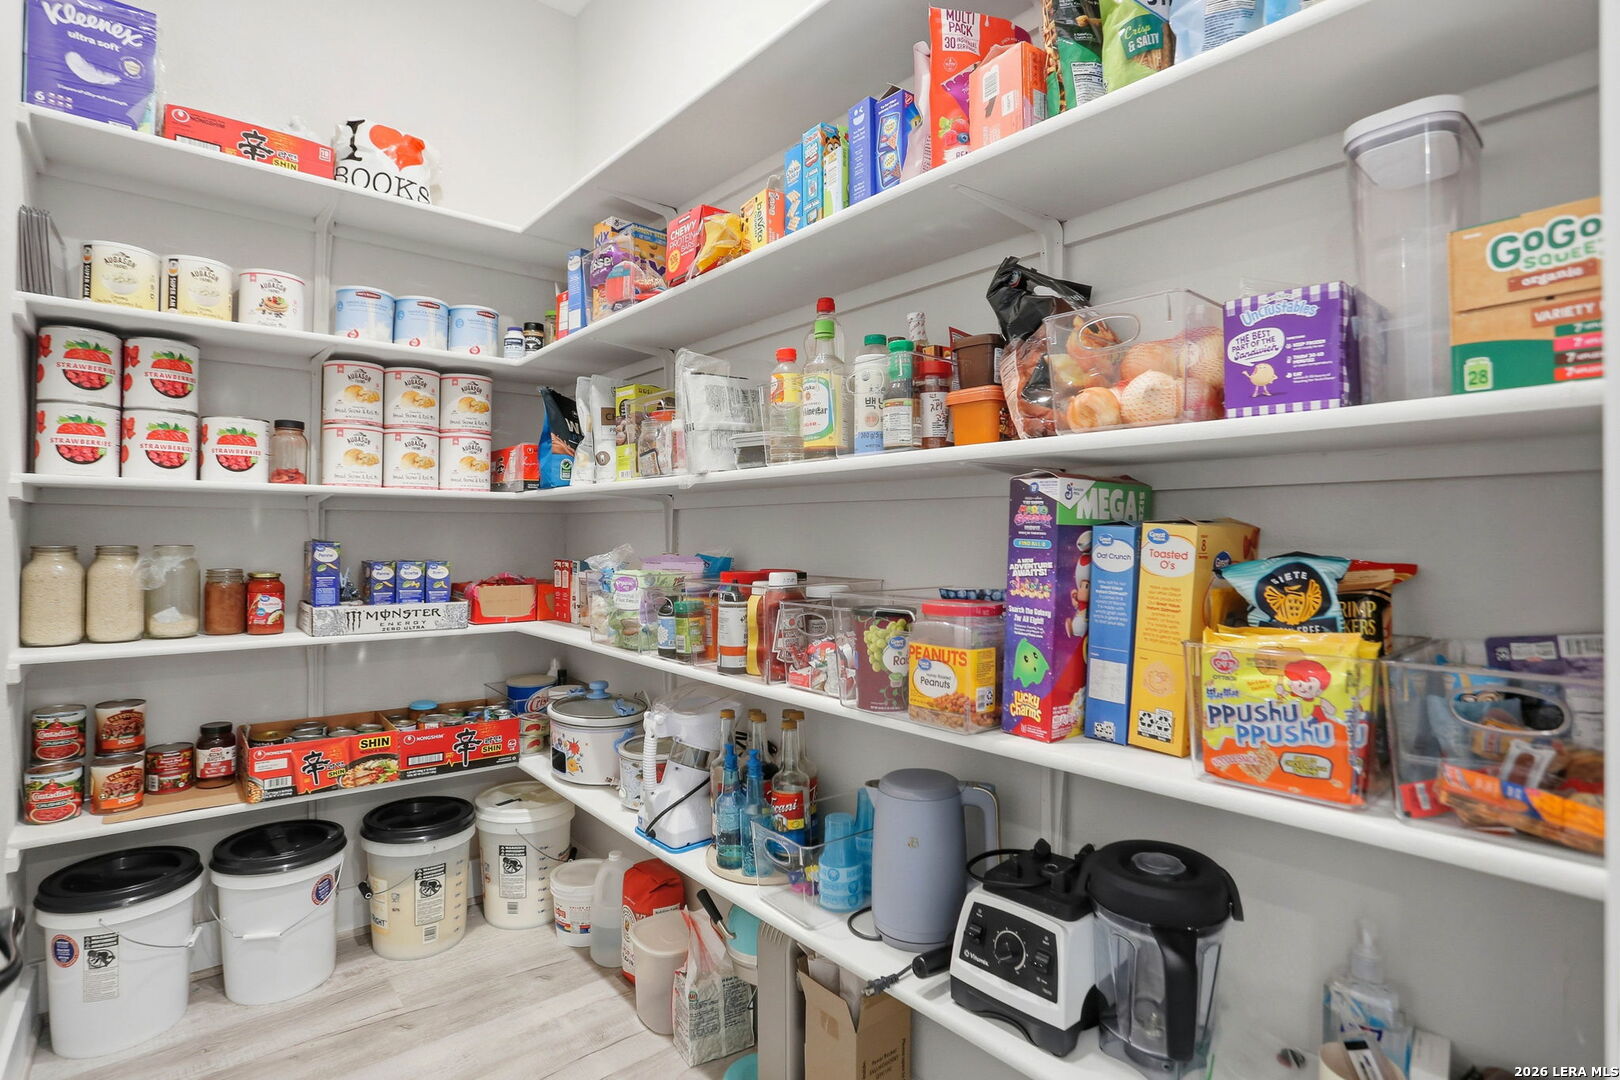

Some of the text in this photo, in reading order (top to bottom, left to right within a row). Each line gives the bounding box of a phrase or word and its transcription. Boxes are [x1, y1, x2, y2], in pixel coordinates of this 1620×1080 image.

[41, 1, 144, 48] Kleenex
[945, 9, 976, 26] MULTI
[948, 21, 974, 37] PACK
[1124, 24, 1152, 39] Crisp
[66, 31, 122, 52] ultra soft
[944, 36, 956, 49] 30
[1128, 32, 1160, 52] & SALTY
[34, 91, 46, 101] 6
[236, 129, 275, 161] 辛
[341, 118, 366, 162] I
[272, 159, 298, 172] SHIN
[335, 165, 431, 205] BOOKS
[670, 219, 697, 240] CHEWY
[669, 232, 696, 249] PROTEIN
[1490, 217, 1602, 270] GoGo
[1520, 266, 1584, 287] organic
[1240, 300, 1319, 327] Uncrustables
[1533, 302, 1596, 323] VARIETY
[1231, 335, 1276, 353] PART OF THE
[1235, 329, 1271, 345] THE BEST
[56, 361, 116, 376] STRAWBERRIES
[144, 371, 197, 384] STRAWBERRIES
[1467, 369, 1489, 387] 28
[802, 406, 828, 417] inegar
[50, 437, 112, 449] STRAWBERRIES
[139, 443, 193, 453] STRAWBERRIES
[211, 447, 262, 456] STRAWBERRIES
[1076, 487, 1138, 522] MEGA
[1108, 552, 1132, 561] Crunch
[1148, 548, 1190, 561] Toasted
[1159, 559, 1176, 571] O's
[1270, 571, 1309, 585] SIETE
[1338, 600, 1377, 618] RIMP
[379, 619, 427, 627] ENERGY
[1344, 618, 1377, 636] KERS
[909, 644, 968, 667] PEANUTS
[920, 676, 951, 690] Peanuts
[1014, 690, 1040, 709] Lucky
[1009, 702, 1042, 723] Charms
[360, 736, 390, 749] SHIN
[453, 728, 483, 767] 辛
[482, 744, 502, 754] SHIN
[301, 750, 331, 786] 辛
[327, 768, 347, 778] SHIN
